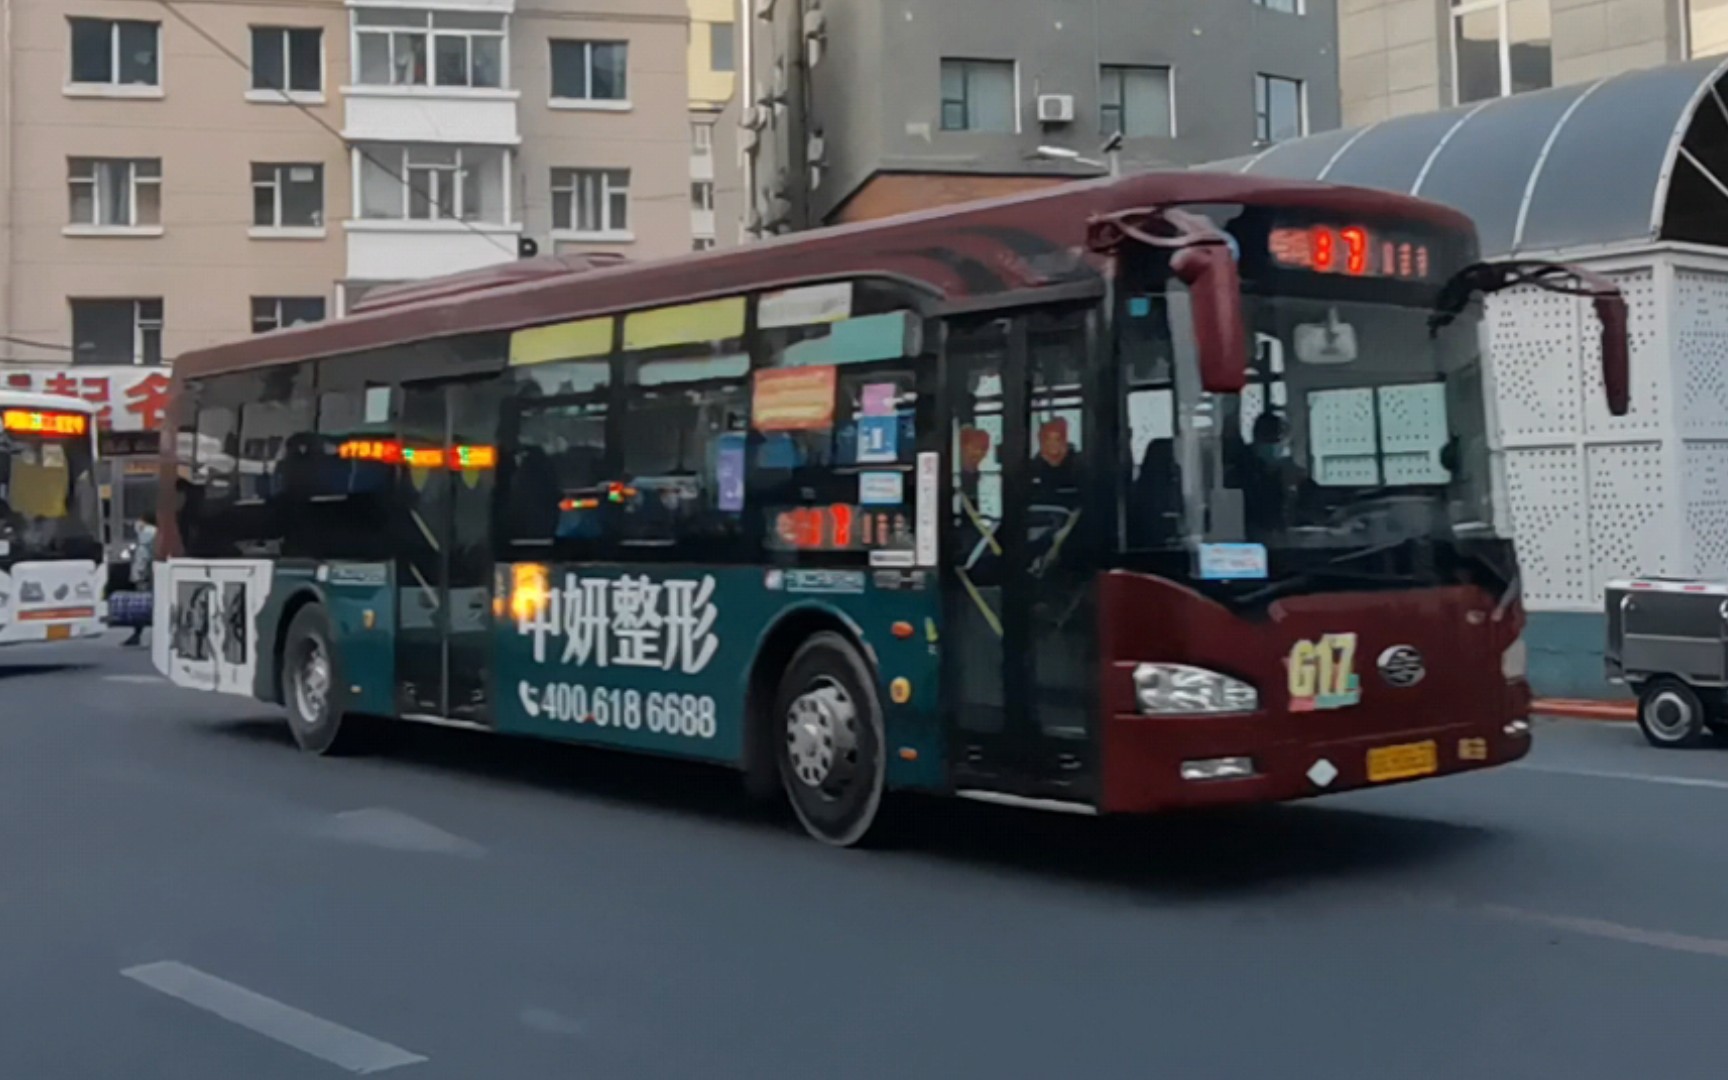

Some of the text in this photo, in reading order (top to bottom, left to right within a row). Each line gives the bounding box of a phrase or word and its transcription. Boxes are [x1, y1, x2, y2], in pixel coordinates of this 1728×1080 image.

[518, 573, 719, 674] 中妍整形
[541, 682, 717, 739] 400 618 6688
